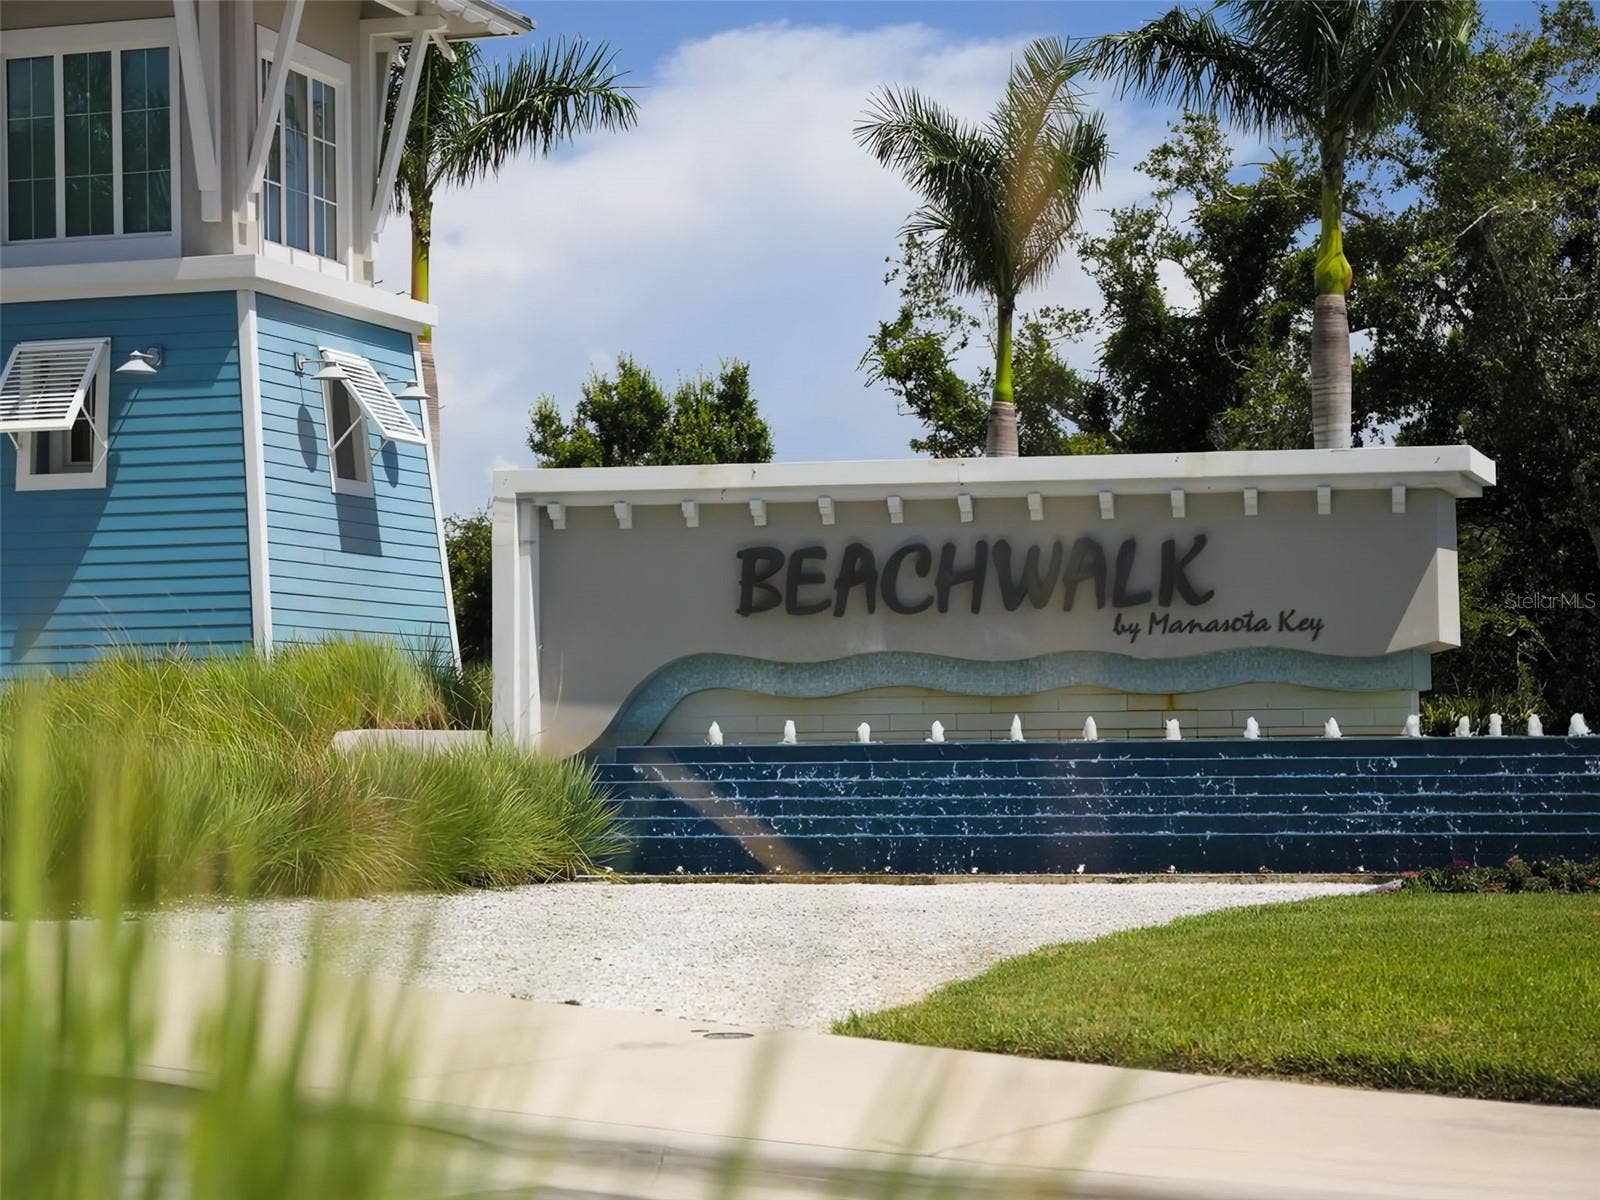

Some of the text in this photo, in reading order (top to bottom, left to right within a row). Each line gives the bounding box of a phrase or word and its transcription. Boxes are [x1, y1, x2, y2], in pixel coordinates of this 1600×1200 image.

[736, 533, 1215, 618] BEACHWALK
[1113, 608, 1325, 643] by Manasota Key
